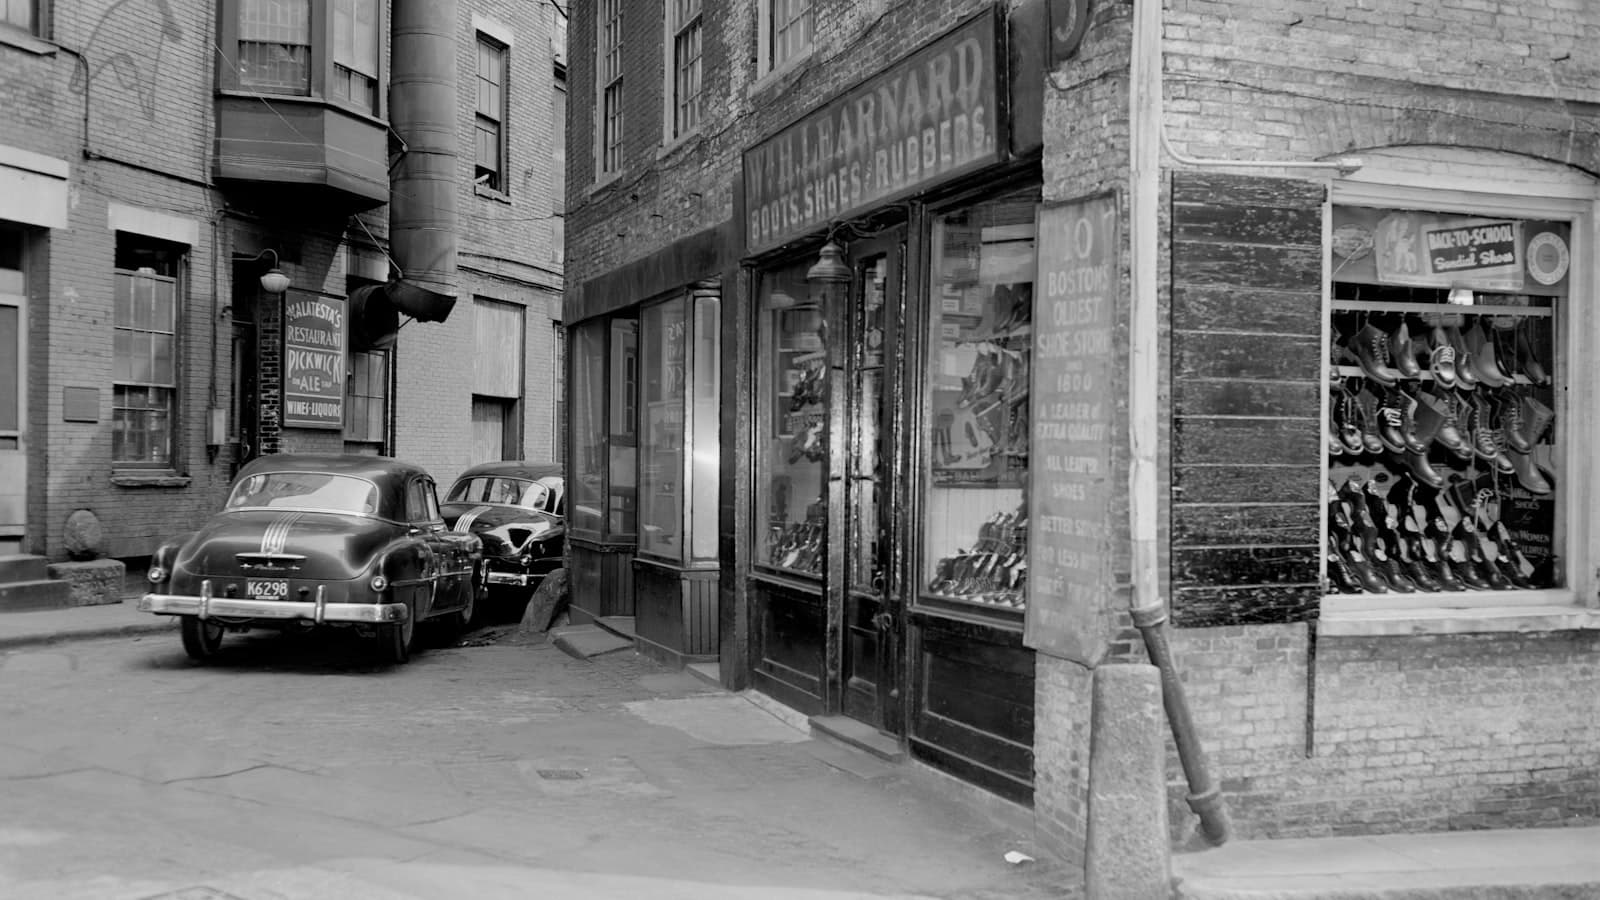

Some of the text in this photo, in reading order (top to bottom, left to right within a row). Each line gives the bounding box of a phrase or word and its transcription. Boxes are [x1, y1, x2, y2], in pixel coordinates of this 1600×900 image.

[286, 301, 342, 329] MALATESTA'S
[1054, 296, 1103, 327] OLDEST
[287, 325, 341, 347] RESTAURANT
[288, 349, 341, 384] PICKWICK
[299, 375, 321, 392] ALE
[247, 581, 288, 596] K6298
